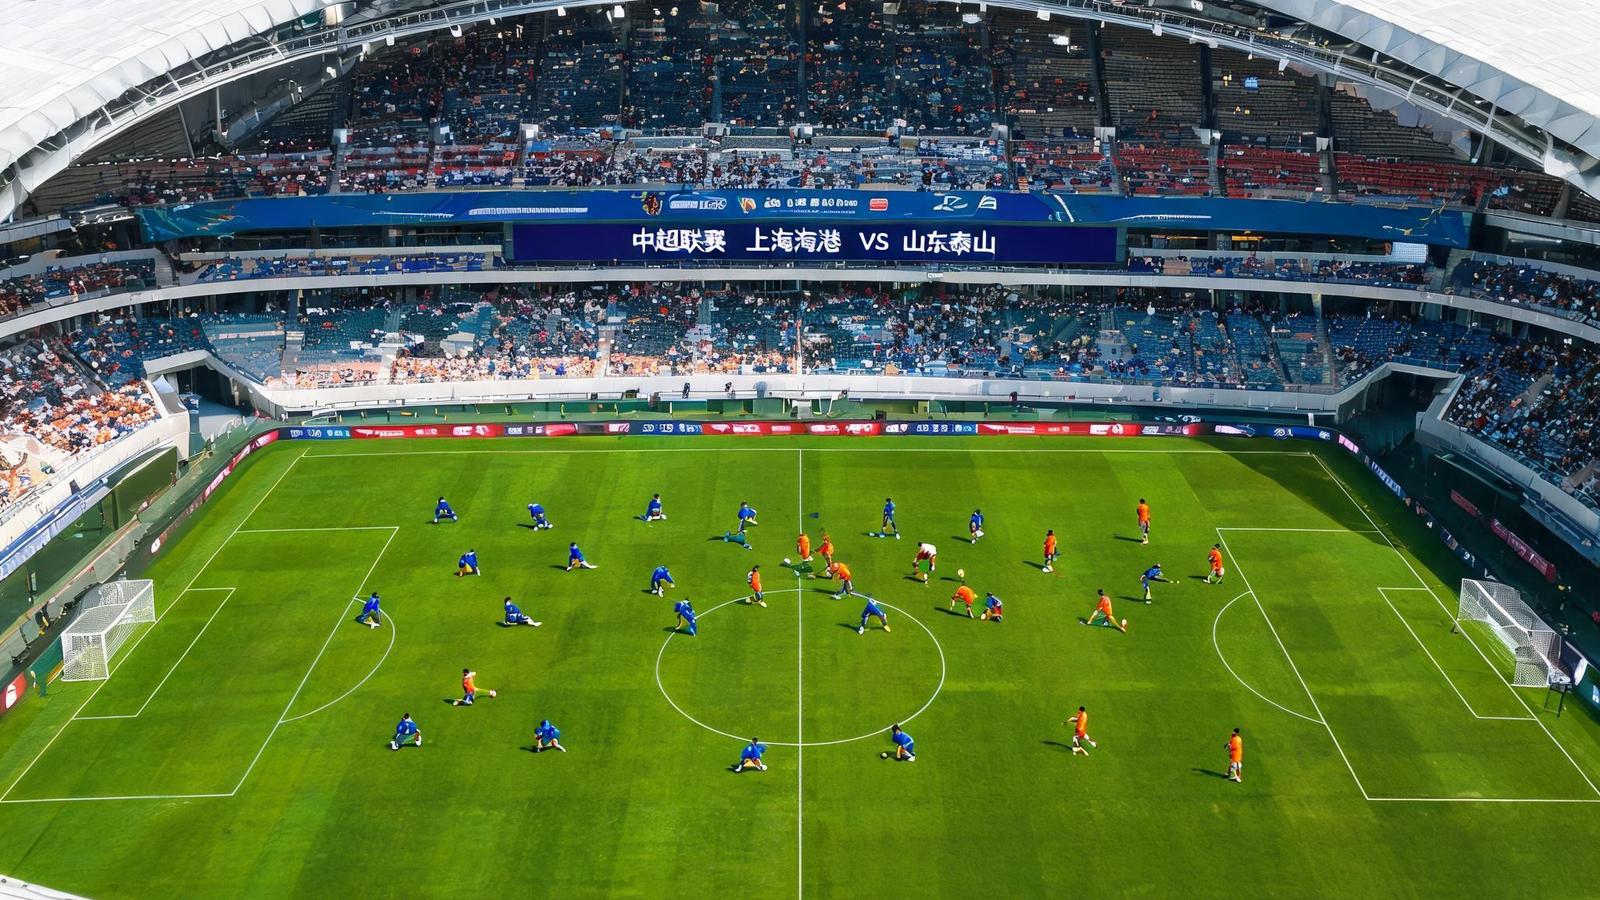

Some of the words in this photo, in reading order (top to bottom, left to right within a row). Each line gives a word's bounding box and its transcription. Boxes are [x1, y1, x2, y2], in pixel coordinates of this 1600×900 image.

[745, 227, 842, 253] 上海海港
[858, 232, 890, 251] VS
[902, 229, 997, 256] 山东泰山
